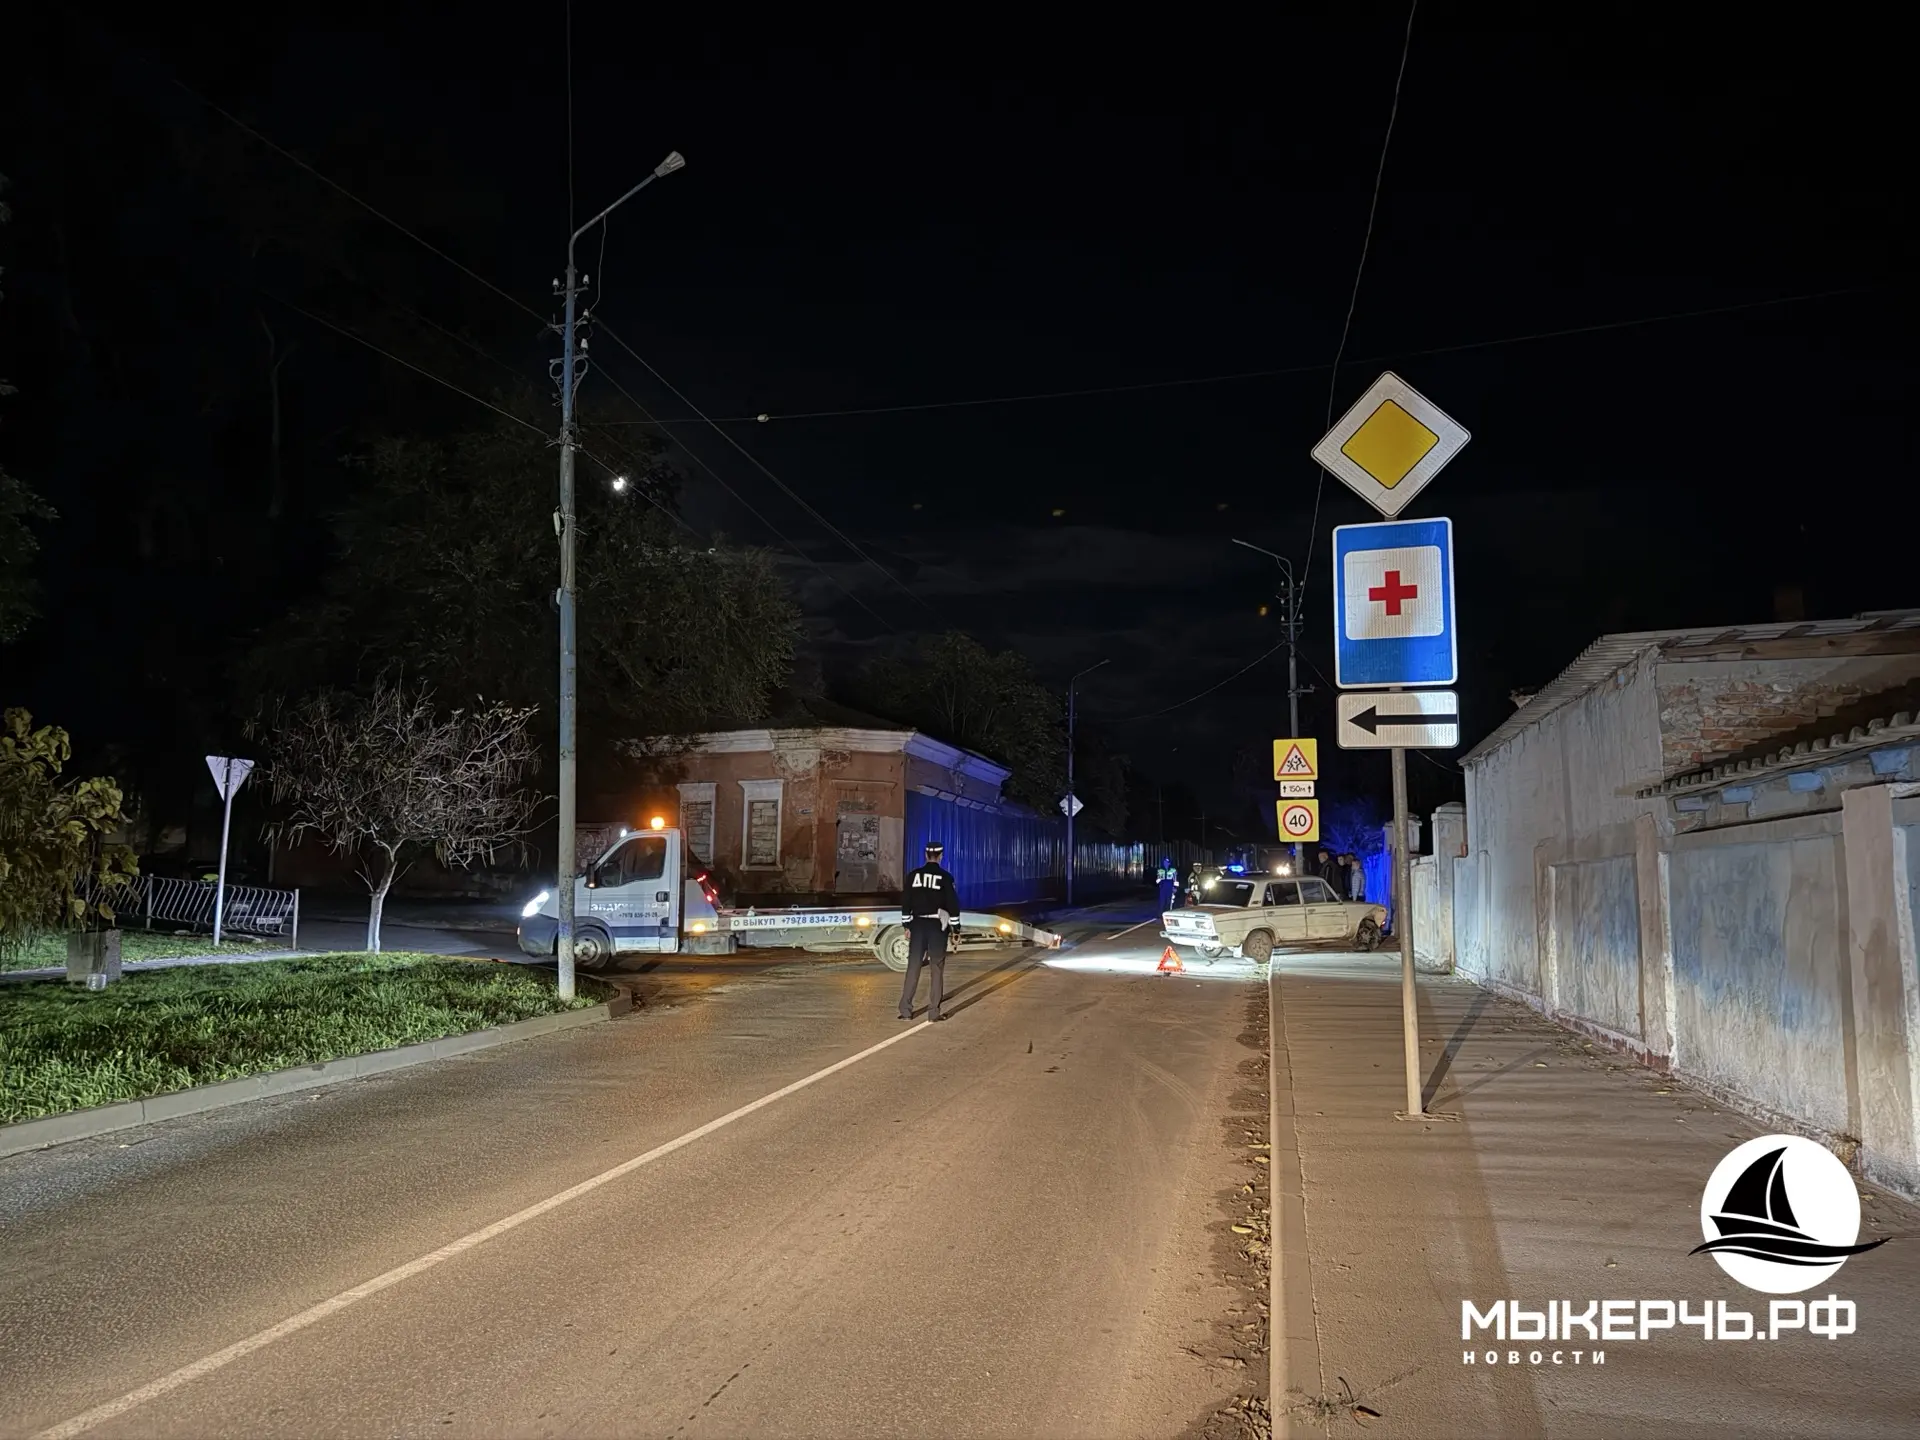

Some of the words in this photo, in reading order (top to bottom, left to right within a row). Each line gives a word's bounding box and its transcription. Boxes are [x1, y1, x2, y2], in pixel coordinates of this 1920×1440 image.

[1289, 814, 1307, 827] 40
[911, 873, 943, 890] ДПС
[743, 918, 775, 926] ВЫКУП
[781, 916, 807, 924] +7978
[809, 915, 852, 923] 834-72-91
